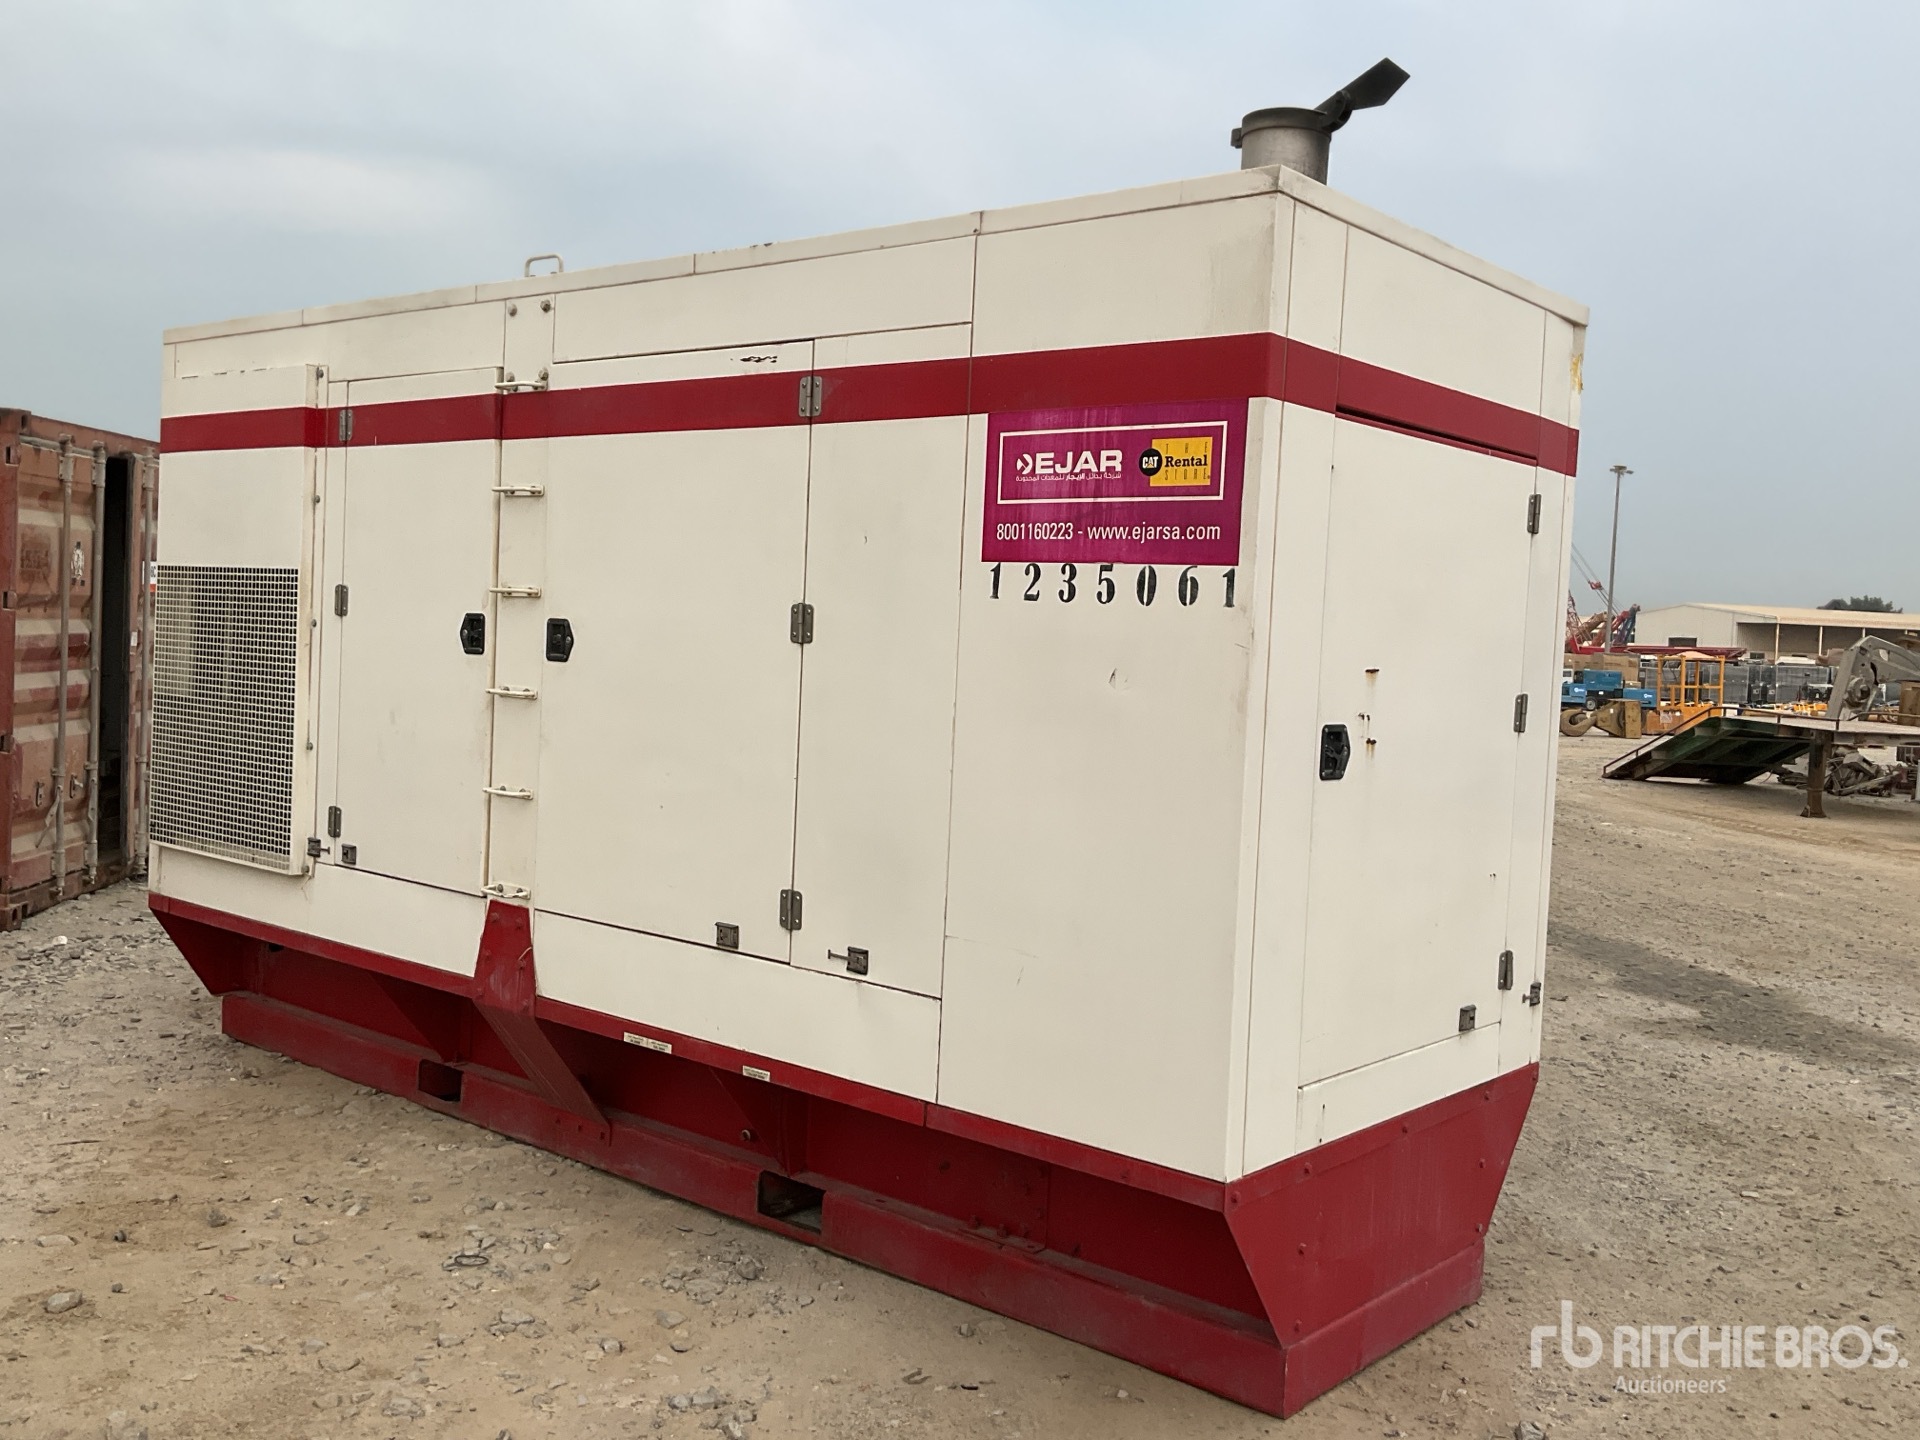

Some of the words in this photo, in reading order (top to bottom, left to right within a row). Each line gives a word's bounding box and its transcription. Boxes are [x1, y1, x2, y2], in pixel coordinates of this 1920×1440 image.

[1035, 449, 1123, 474] EJAR
[1142, 456, 1159, 469] CAT
[1164, 454, 1208, 467] Rental
[996, 522, 1074, 540] 8001160223
[1087, 523, 1221, 544] www.ejarsa.com
